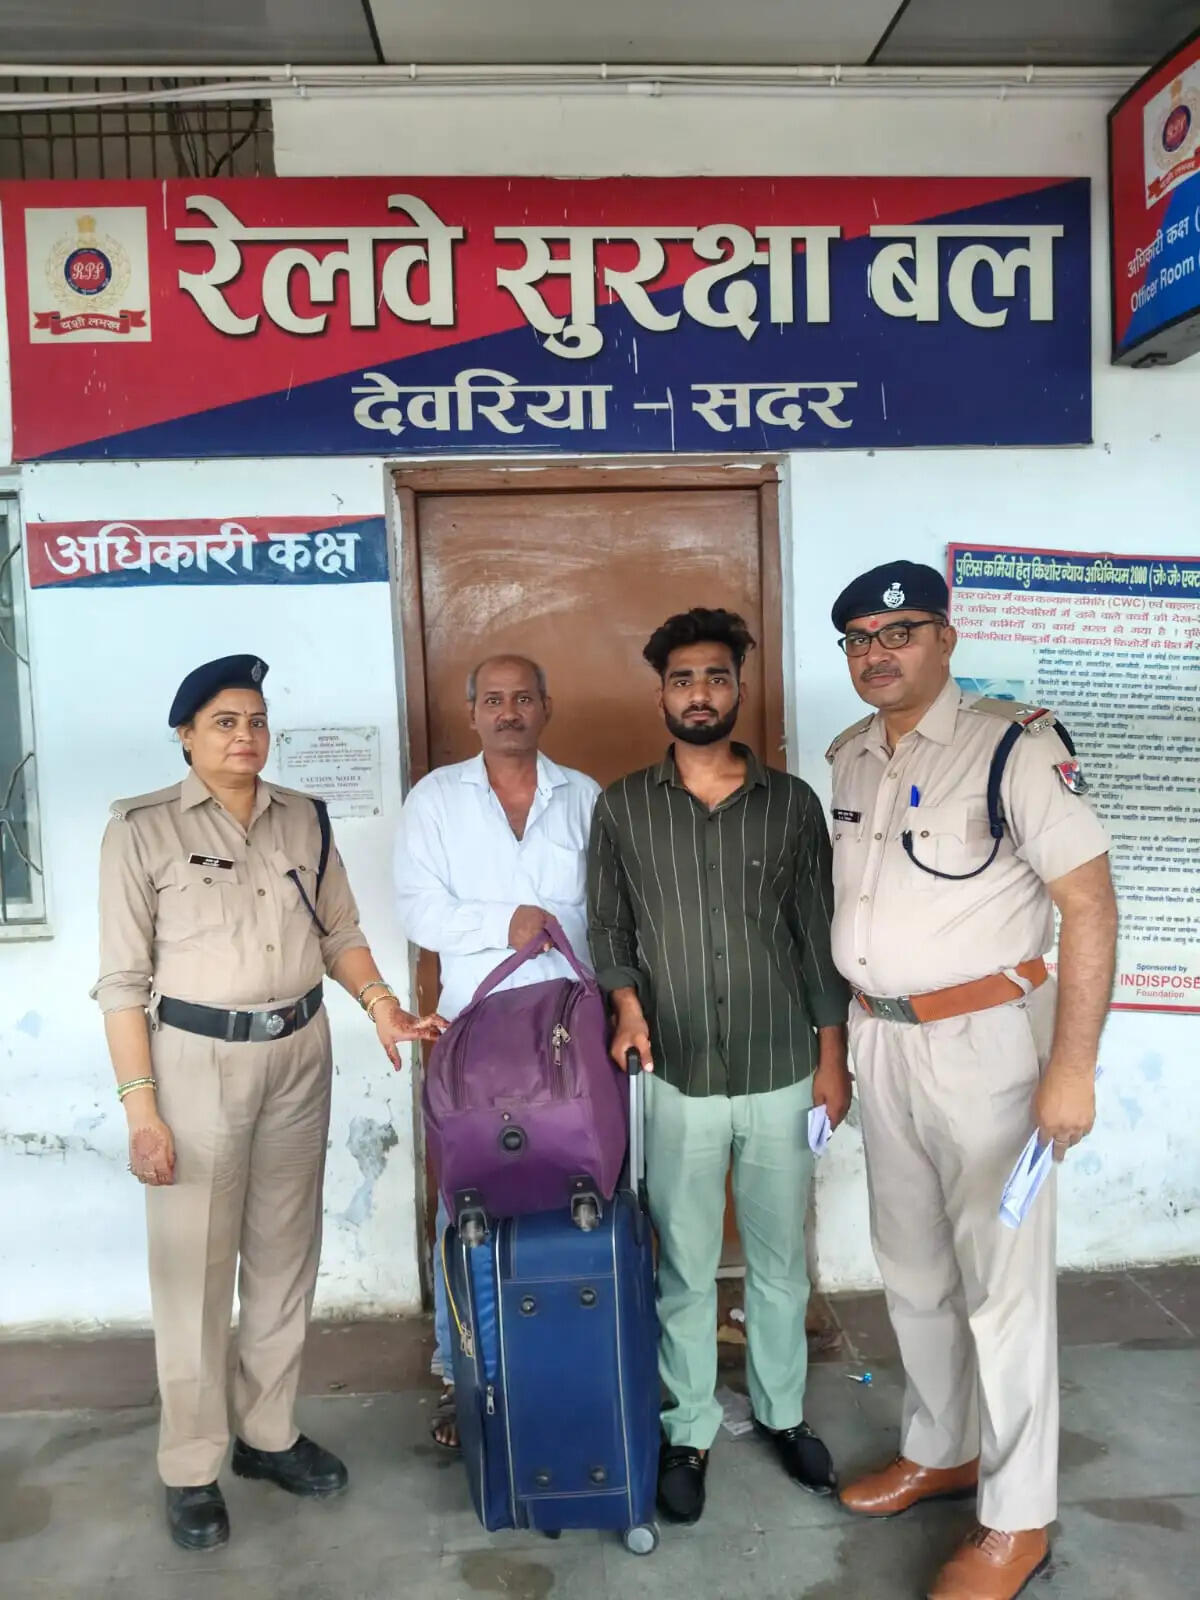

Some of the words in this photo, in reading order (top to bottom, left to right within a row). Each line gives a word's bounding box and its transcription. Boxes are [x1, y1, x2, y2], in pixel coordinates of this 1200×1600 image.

[1128, 229, 1163, 278] अधिकारी
[1166, 216, 1190, 244] कक्ष
[175, 194, 464, 335] रेलवे
[494, 224, 841, 359] सुरक्षा
[870, 225, 1064, 327] बल
[1131, 278, 1158, 312] Officer
[1160, 256, 1194, 290] Room
[352, 369, 613, 435] देवरिया
[691, 382, 858, 431] सदर
[45, 522, 258, 575] अधिकारी
[268, 532, 361, 577] कक्ष
[956, 552, 983, 584] पुलिस
[1016, 556, 1031, 588] हेतु
[1032, 556, 1061, 581] किशोर
[1061, 564, 1084, 582] न्याय
[1085, 560, 1129, 584] अधिनियम
[1130, 566, 1147, 585] 2000
[1032, 622, 1046, 630] का
[1108, 598, 1146, 609] (CWC)
[1136, 962, 1177, 971] Sponsored
[1178, 965, 1188, 973] by
[1136, 988, 1185, 998] Foundation
